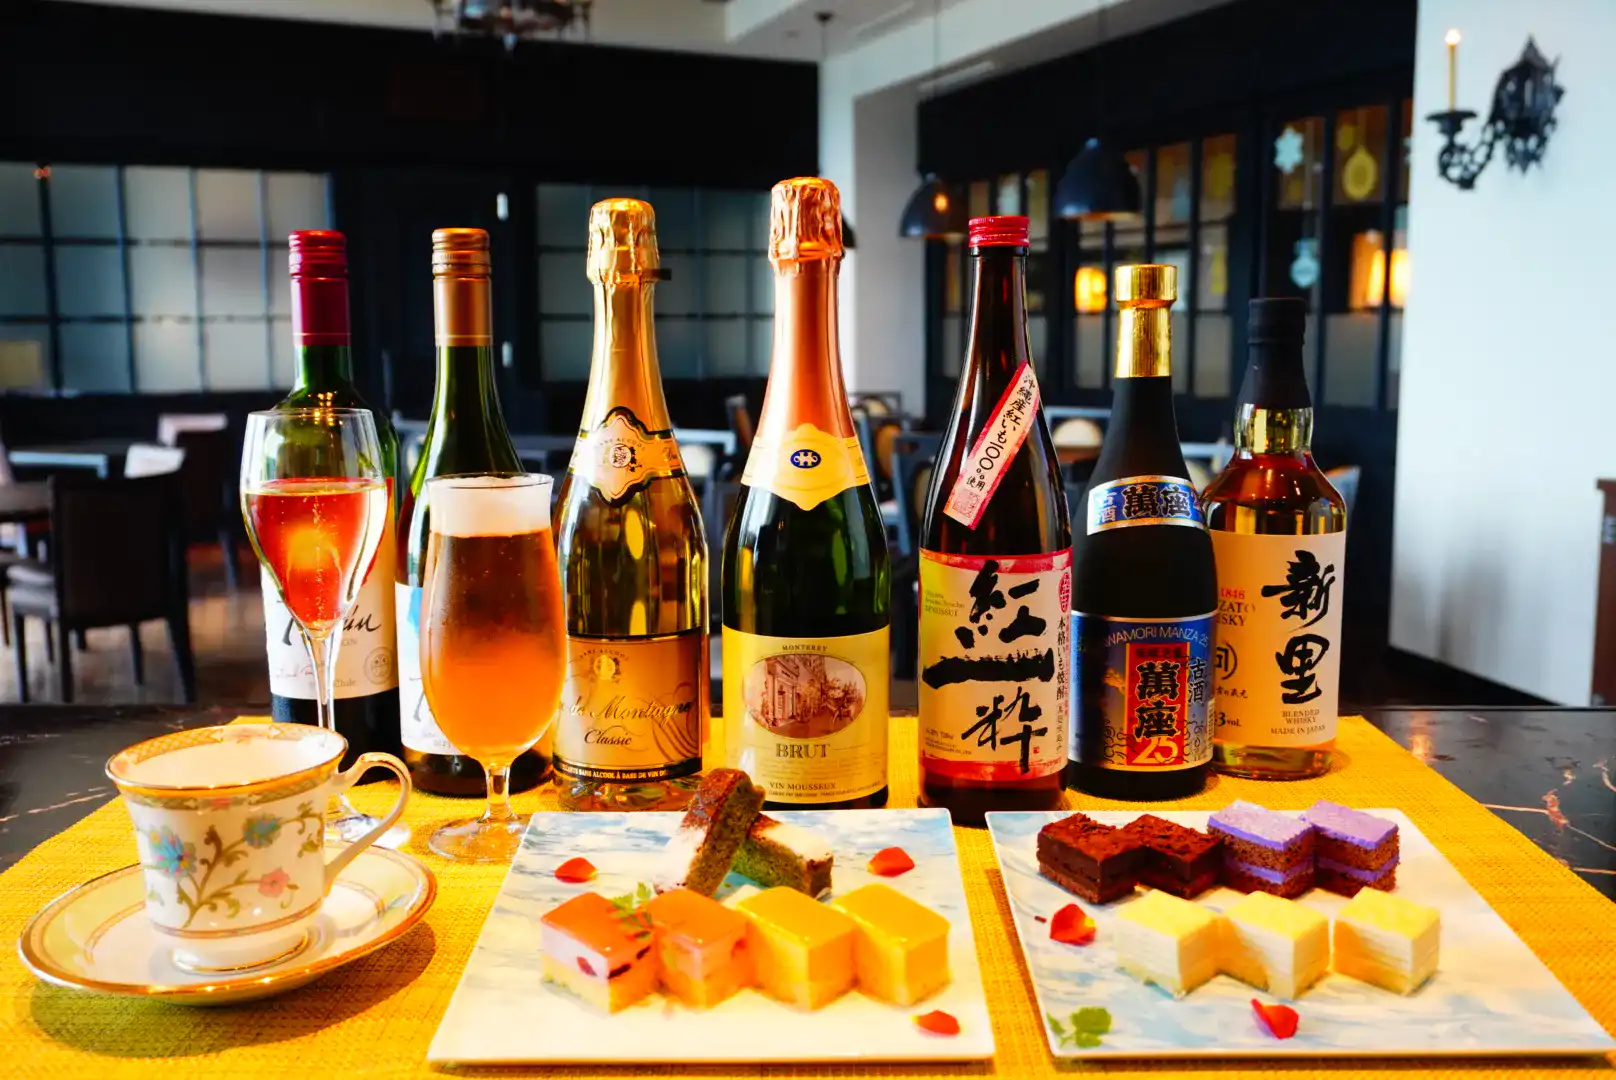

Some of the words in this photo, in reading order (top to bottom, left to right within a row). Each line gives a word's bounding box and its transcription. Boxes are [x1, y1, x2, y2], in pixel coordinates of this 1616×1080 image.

[1261, 550, 1336, 705] 新里
[1104, 627, 1157, 648] WAMORI
[1160, 627, 1199, 643] MANZA
[782, 644, 828, 652] MONTEREY
[1188, 656, 1208, 704] 古酒
[1134, 660, 1181, 741] 萬座
[584, 728, 632, 746] Classic
[1270, 727, 1295, 735] MADE
[775, 743, 831, 758] BRUT
[1132, 736, 1180, 764] 25
[769, 781, 785, 790] VIN
[786, 782, 836, 791] MOUSSEUX
